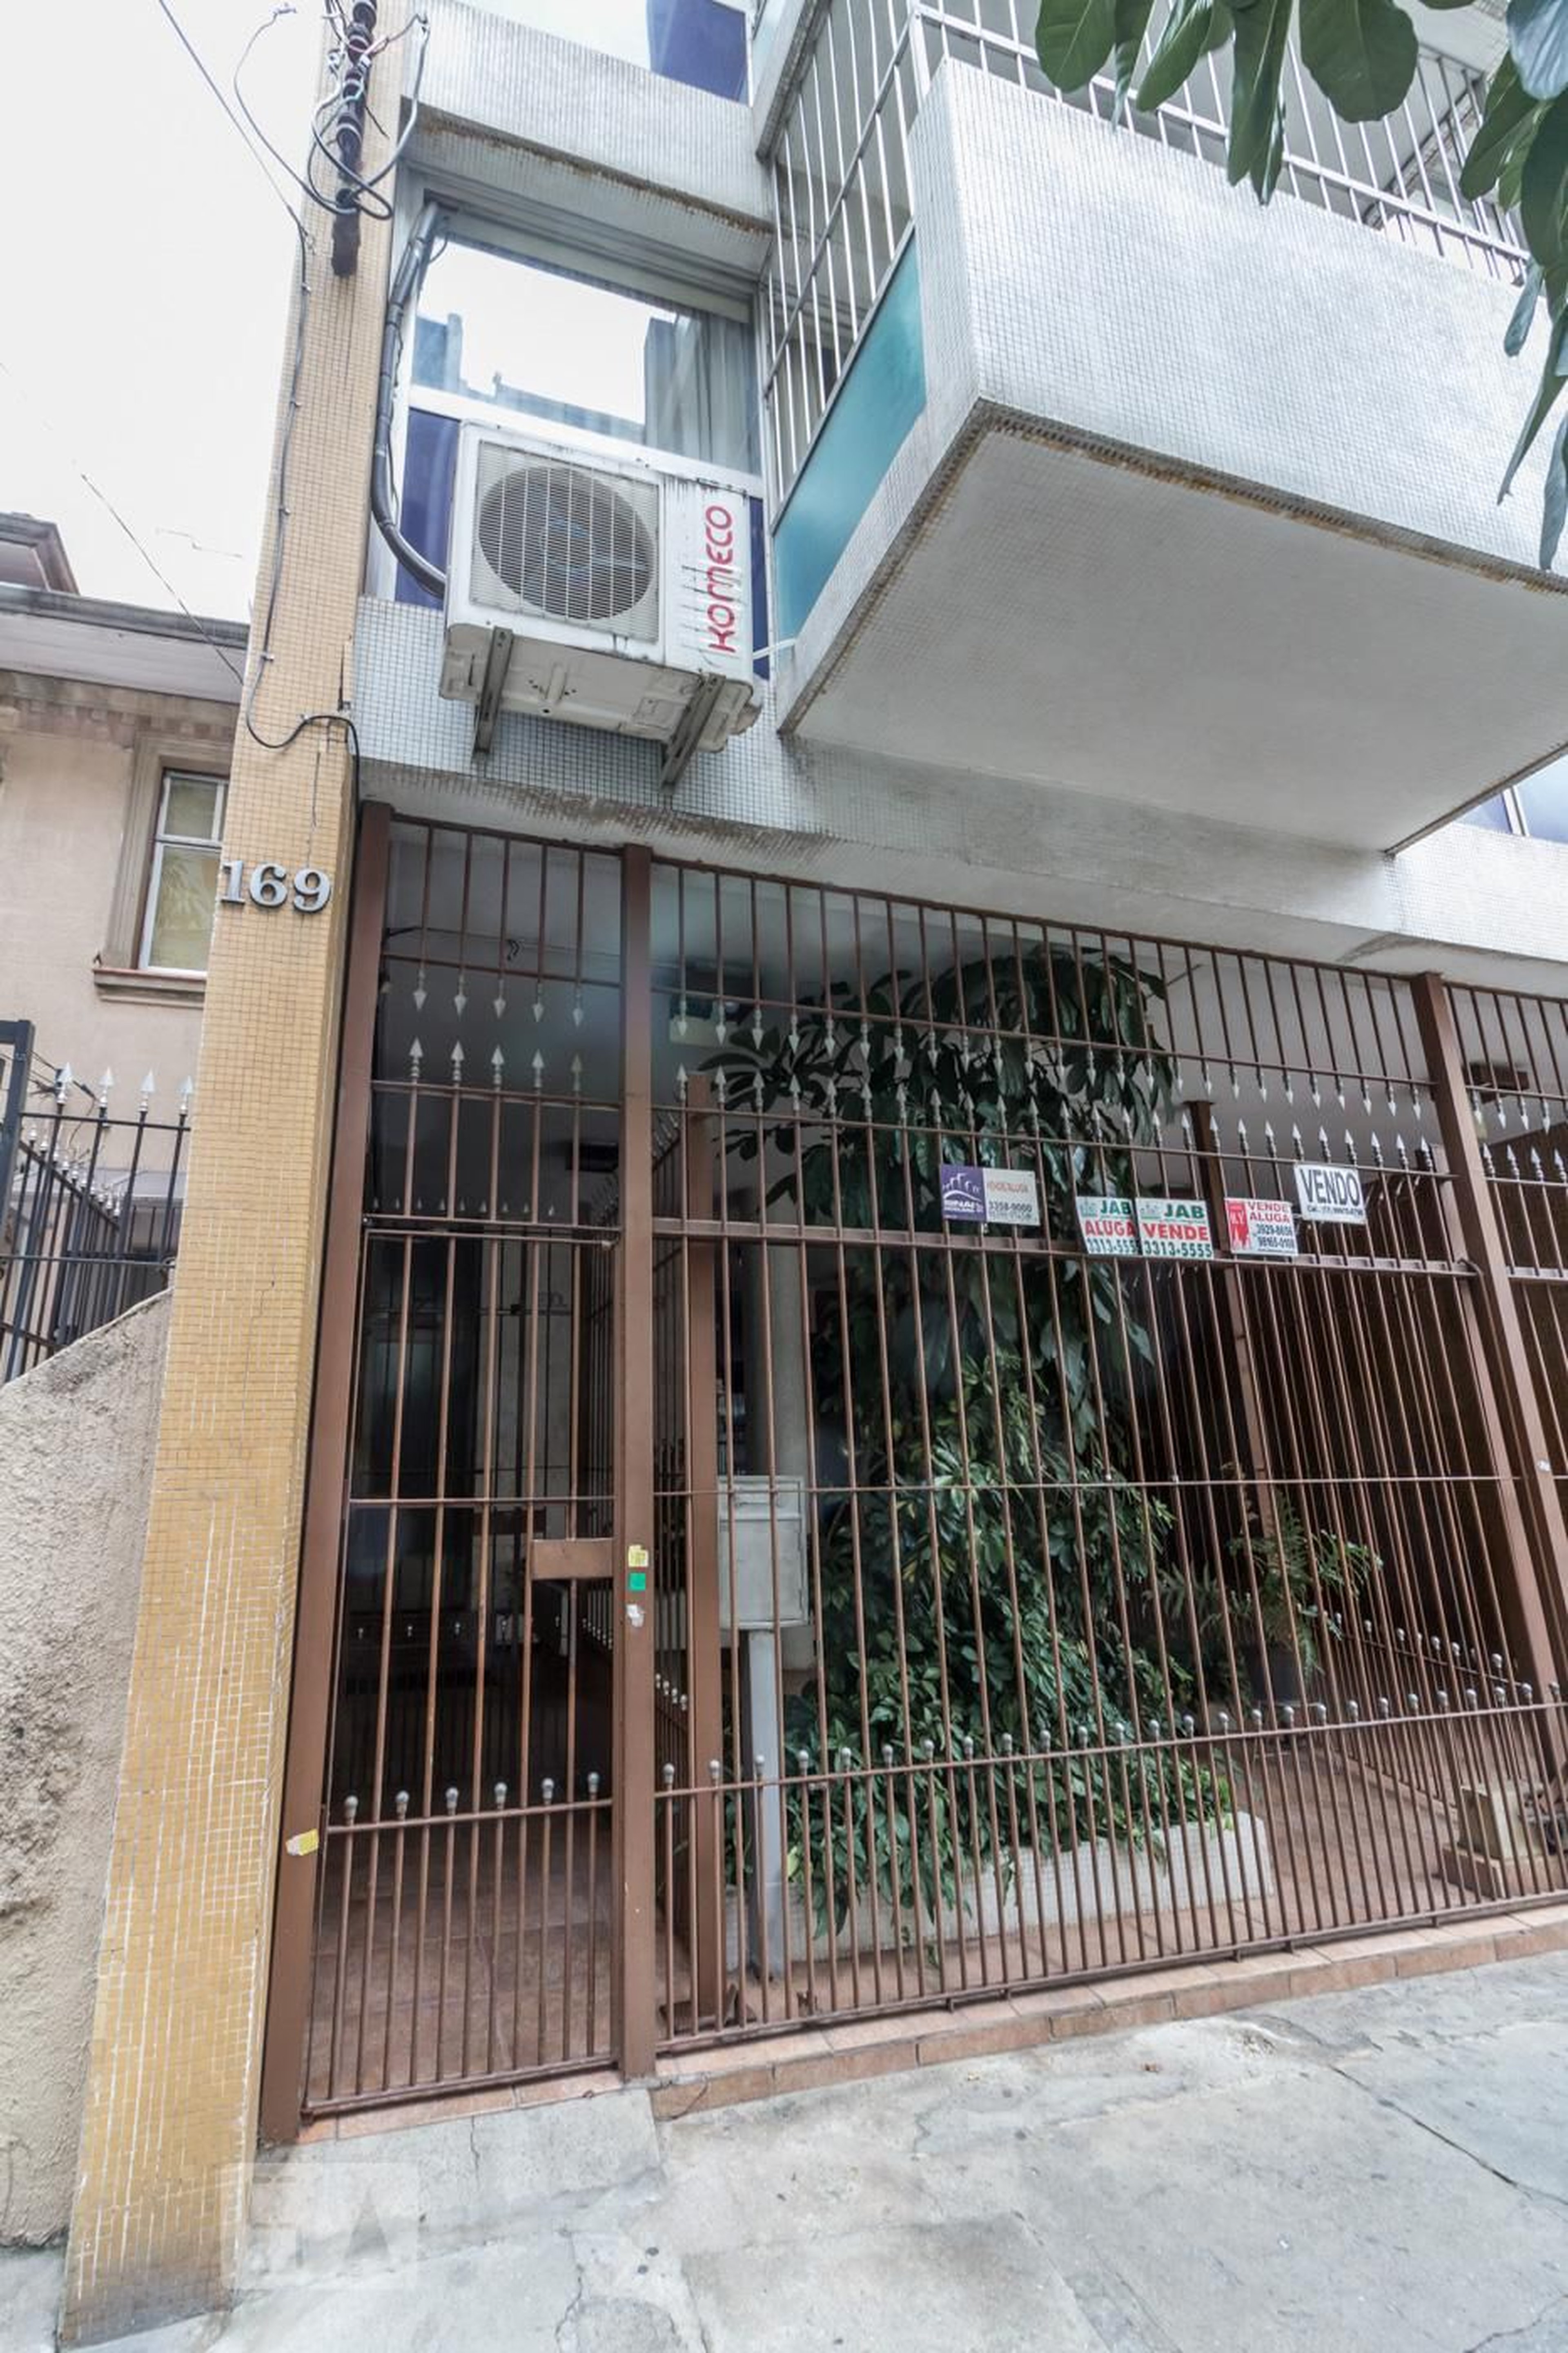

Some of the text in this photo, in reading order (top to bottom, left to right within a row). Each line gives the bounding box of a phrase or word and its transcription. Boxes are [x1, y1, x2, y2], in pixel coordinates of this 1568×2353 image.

[705, 506, 736, 652] KOMECO
[221, 860, 332, 913] 169
[1299, 1168, 1360, 1206] VENDO
[1101, 1200, 1131, 1214] JAB
[1165, 1203, 1205, 1219] JAB
[1248, 1201, 1290, 1213] VENDE
[1250, 1212, 1290, 1223] ALUGA
[1085, 1219, 1136, 1237] ALUGA
[1143, 1223, 1209, 1241] VENDE
